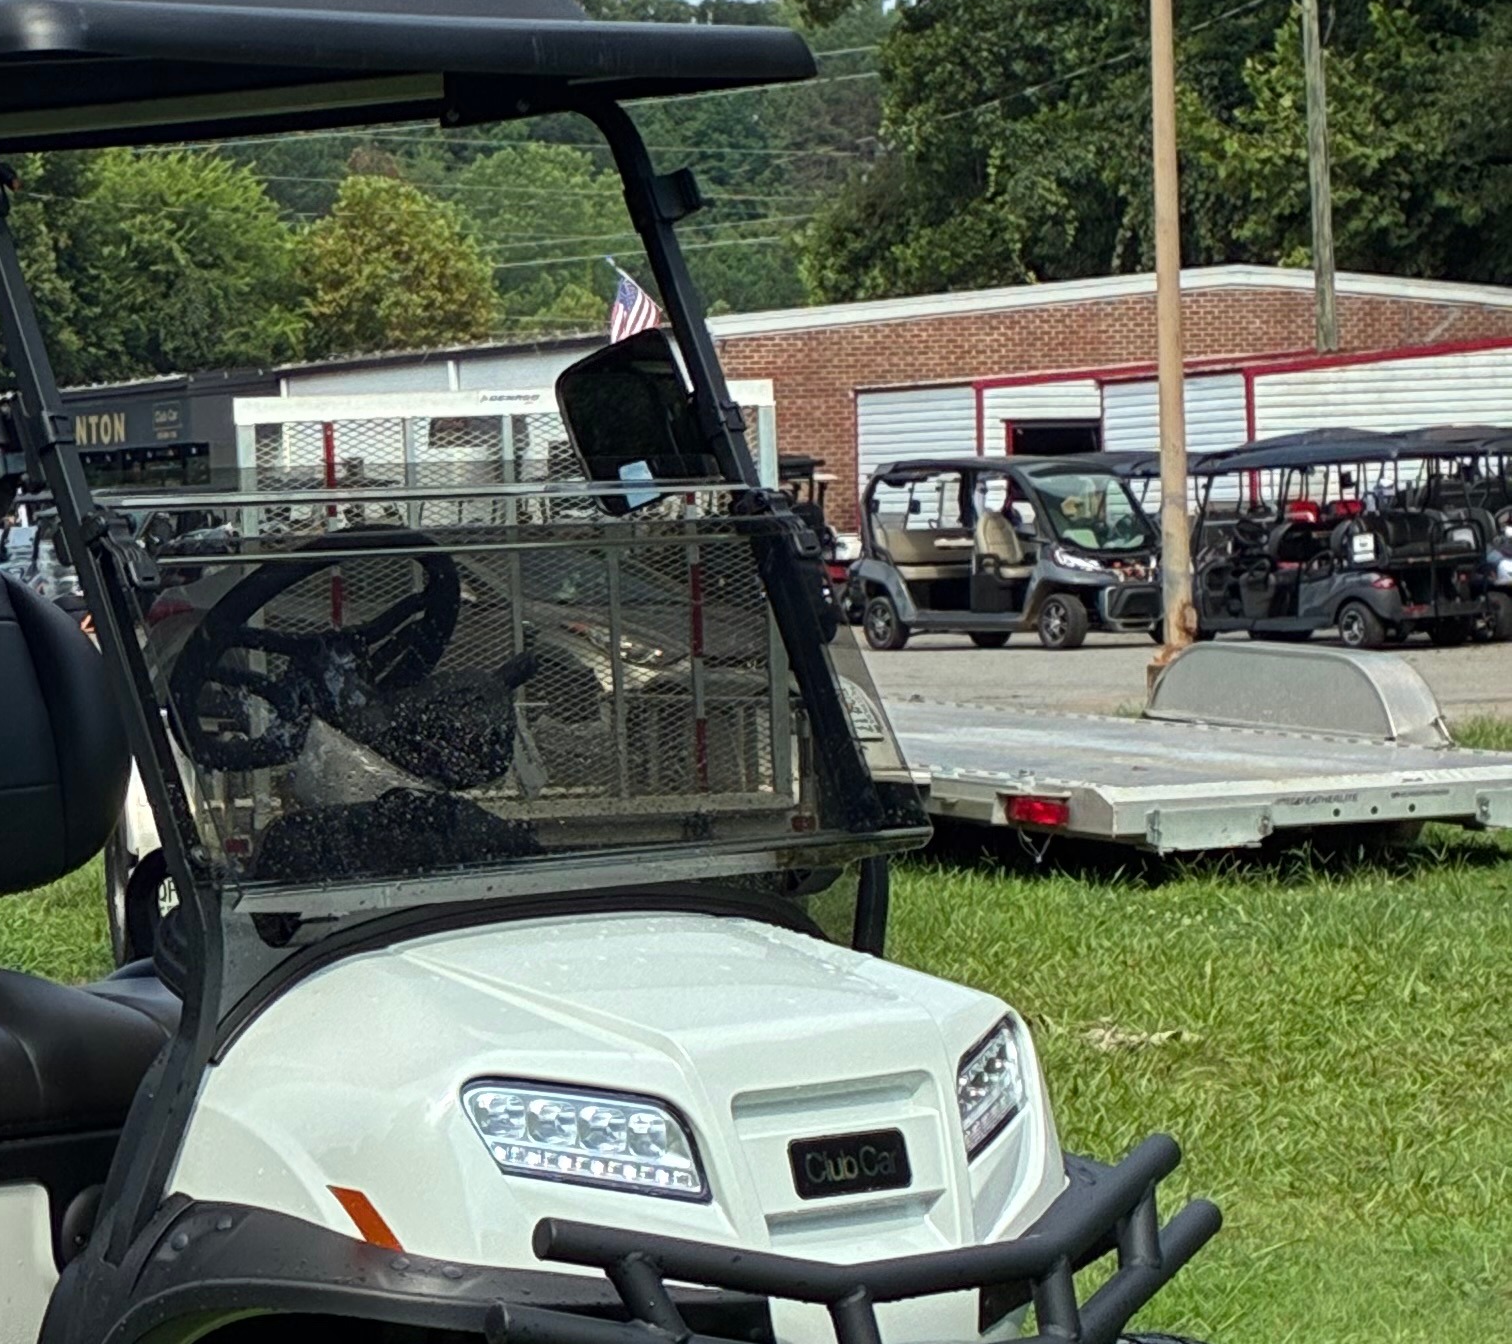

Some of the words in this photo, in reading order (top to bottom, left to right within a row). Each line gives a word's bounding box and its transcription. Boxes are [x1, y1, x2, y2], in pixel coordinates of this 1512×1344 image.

[75, 412, 126, 446] NTON
[805, 1149, 858, 1183] Club
[859, 1145, 897, 1176] Car
